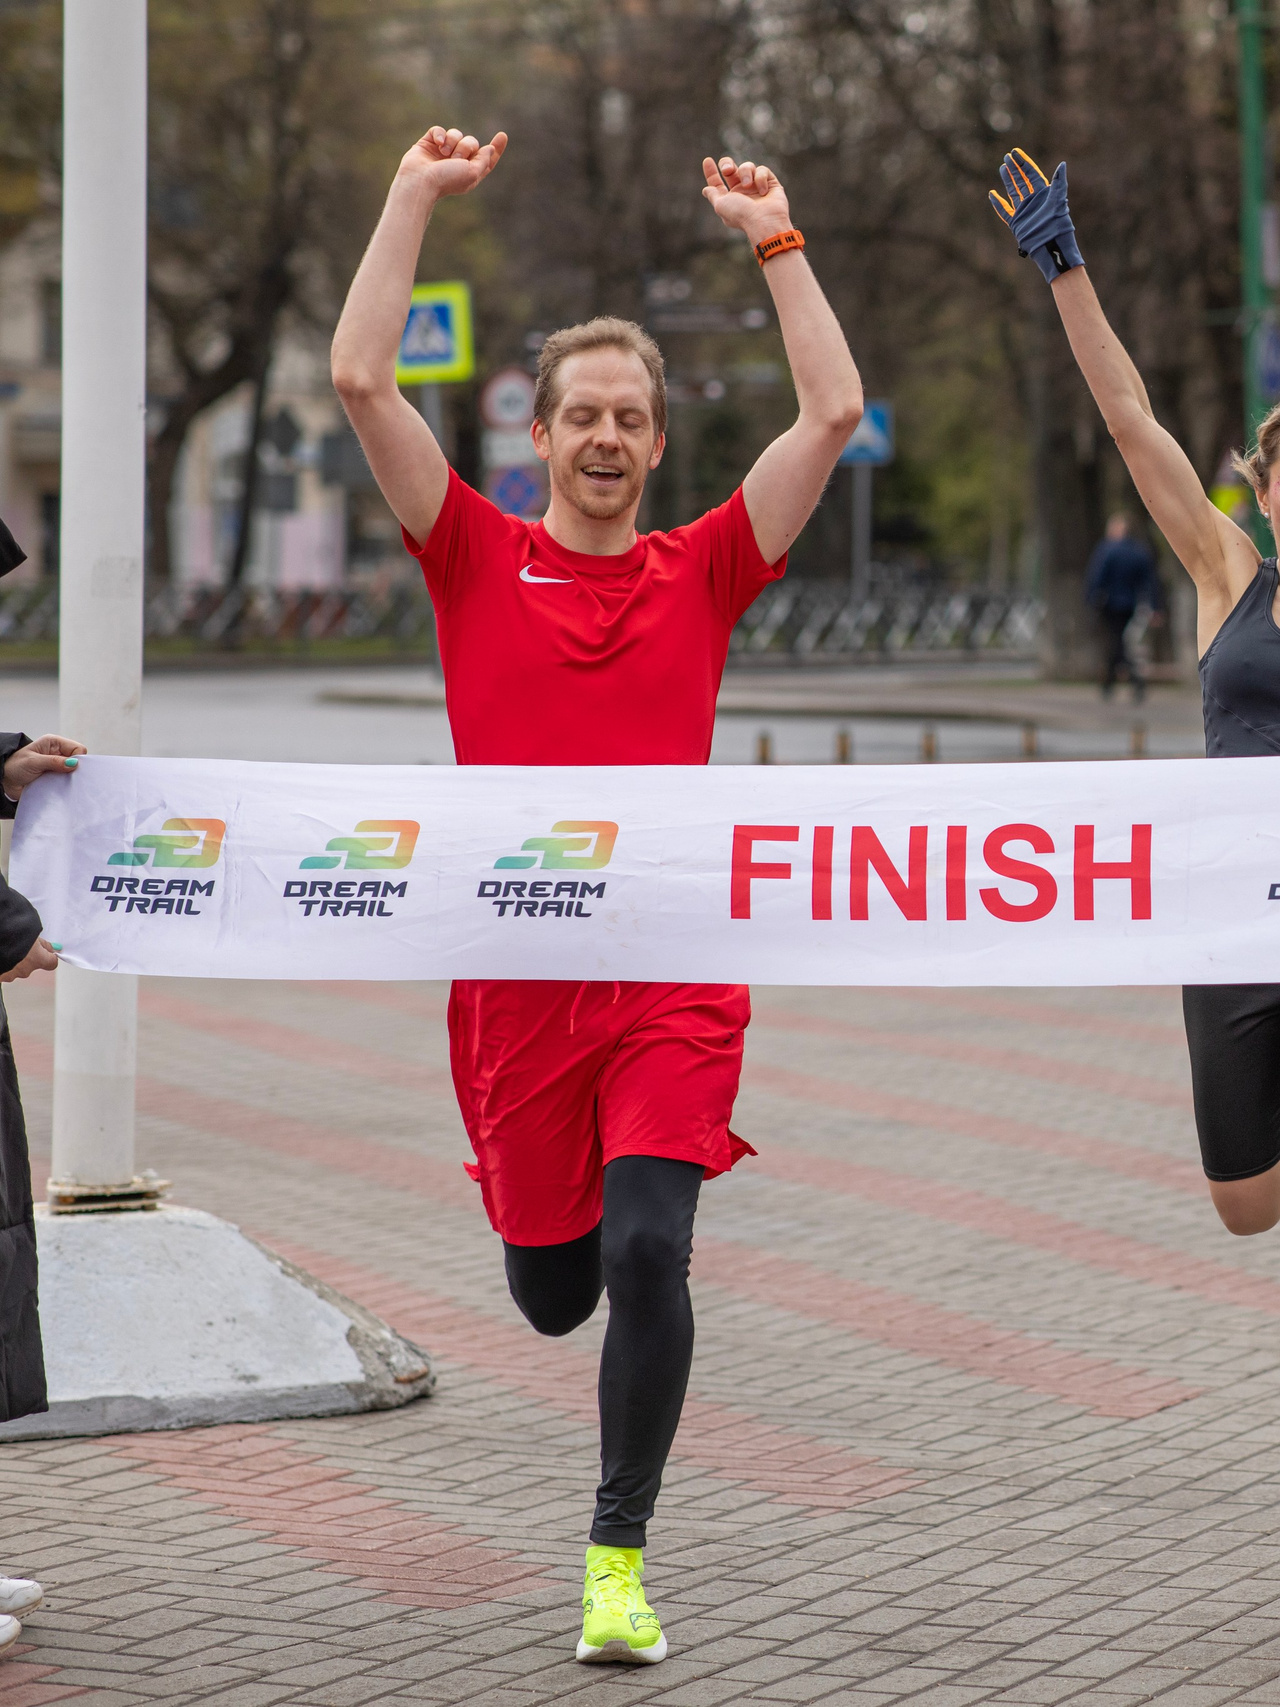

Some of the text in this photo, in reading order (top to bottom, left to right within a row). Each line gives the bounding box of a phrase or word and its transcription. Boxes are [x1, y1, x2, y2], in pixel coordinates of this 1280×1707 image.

[729, 822, 1153, 923] FINISH
[90, 875, 216, 897] DREAM
[283, 881, 408, 898] DREAM
[477, 881, 607, 899] DREAM
[104, 895, 201, 916] TRAIL
[298, 900, 394, 917] TRAIL
[492, 900, 592, 918] TRAIL
